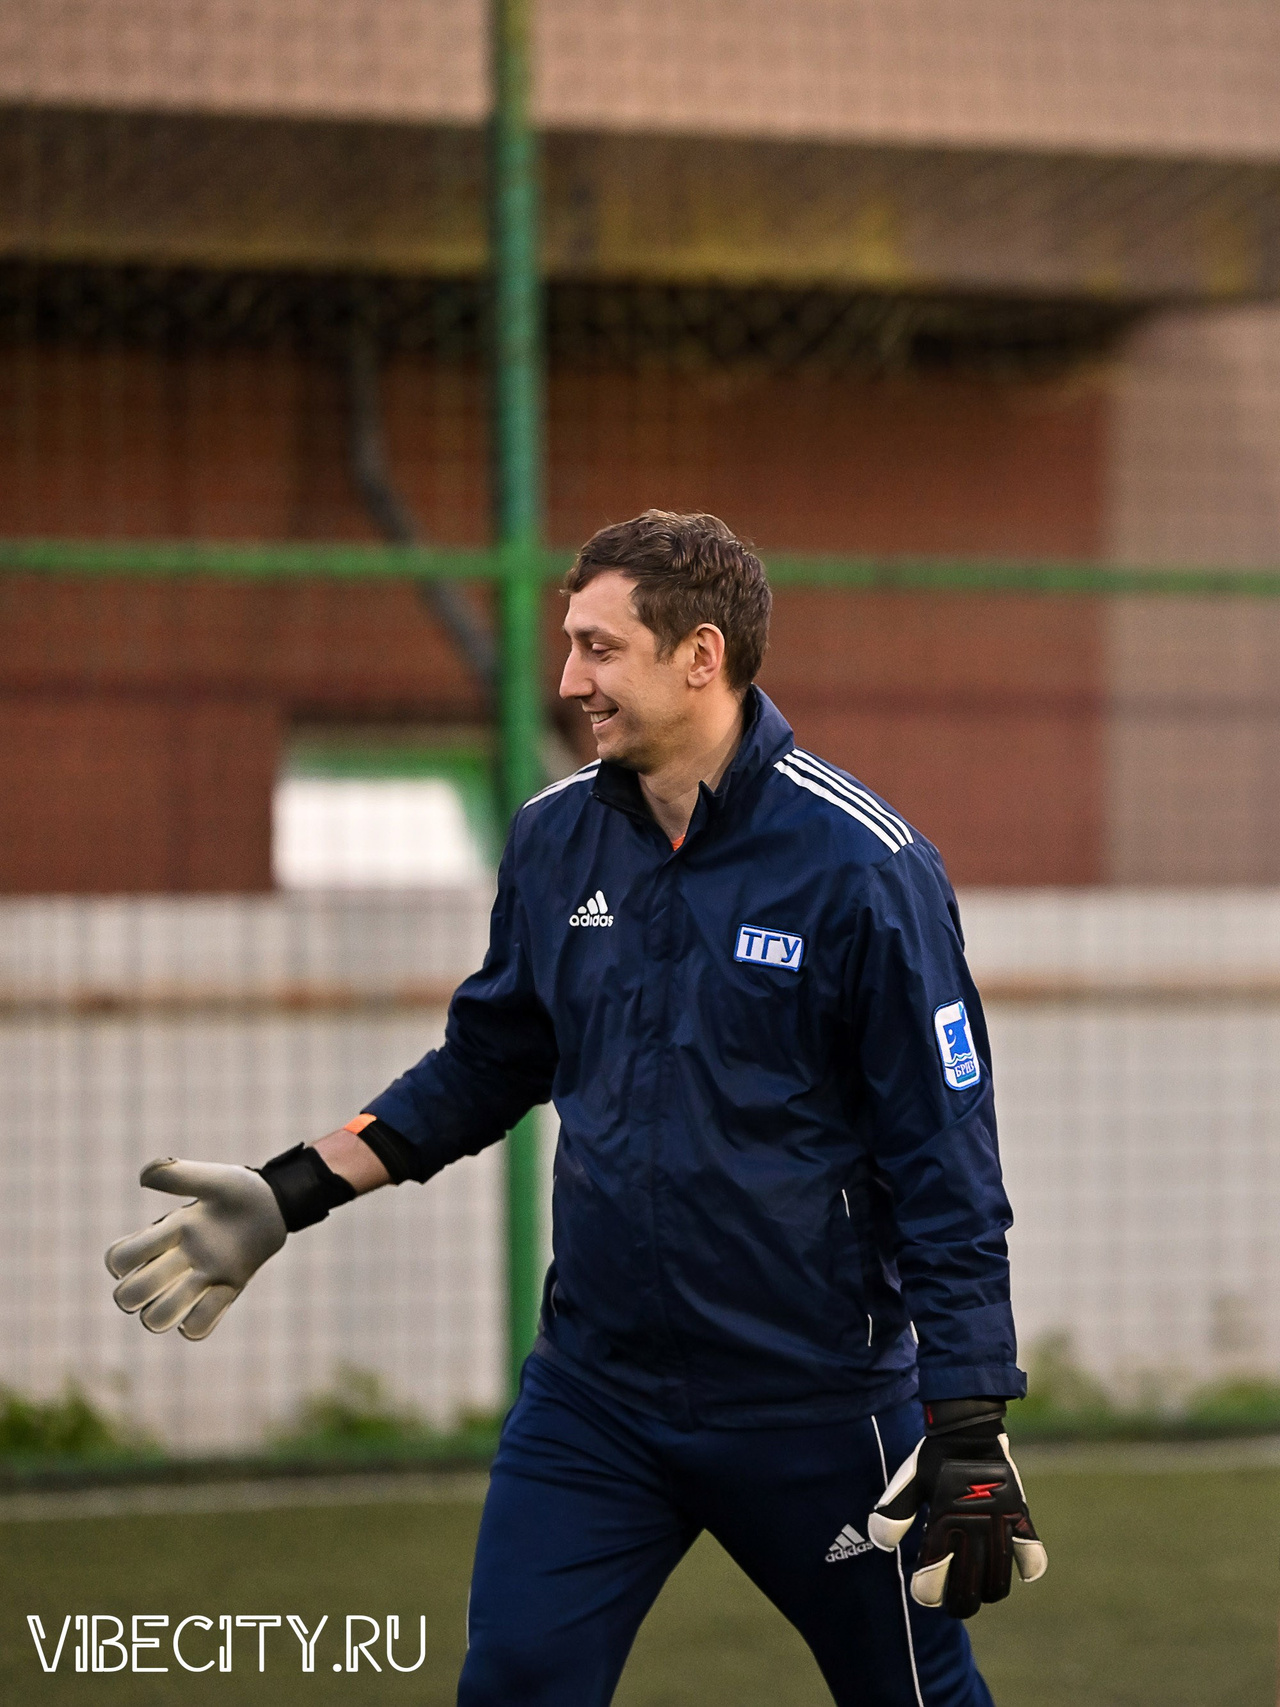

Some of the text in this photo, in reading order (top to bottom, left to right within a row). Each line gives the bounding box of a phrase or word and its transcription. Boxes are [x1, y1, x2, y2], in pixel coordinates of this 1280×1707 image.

[569, 914, 614, 927] adidas
[742, 930, 800, 963] ТГУ
[825, 1541, 874, 1563] adidas
